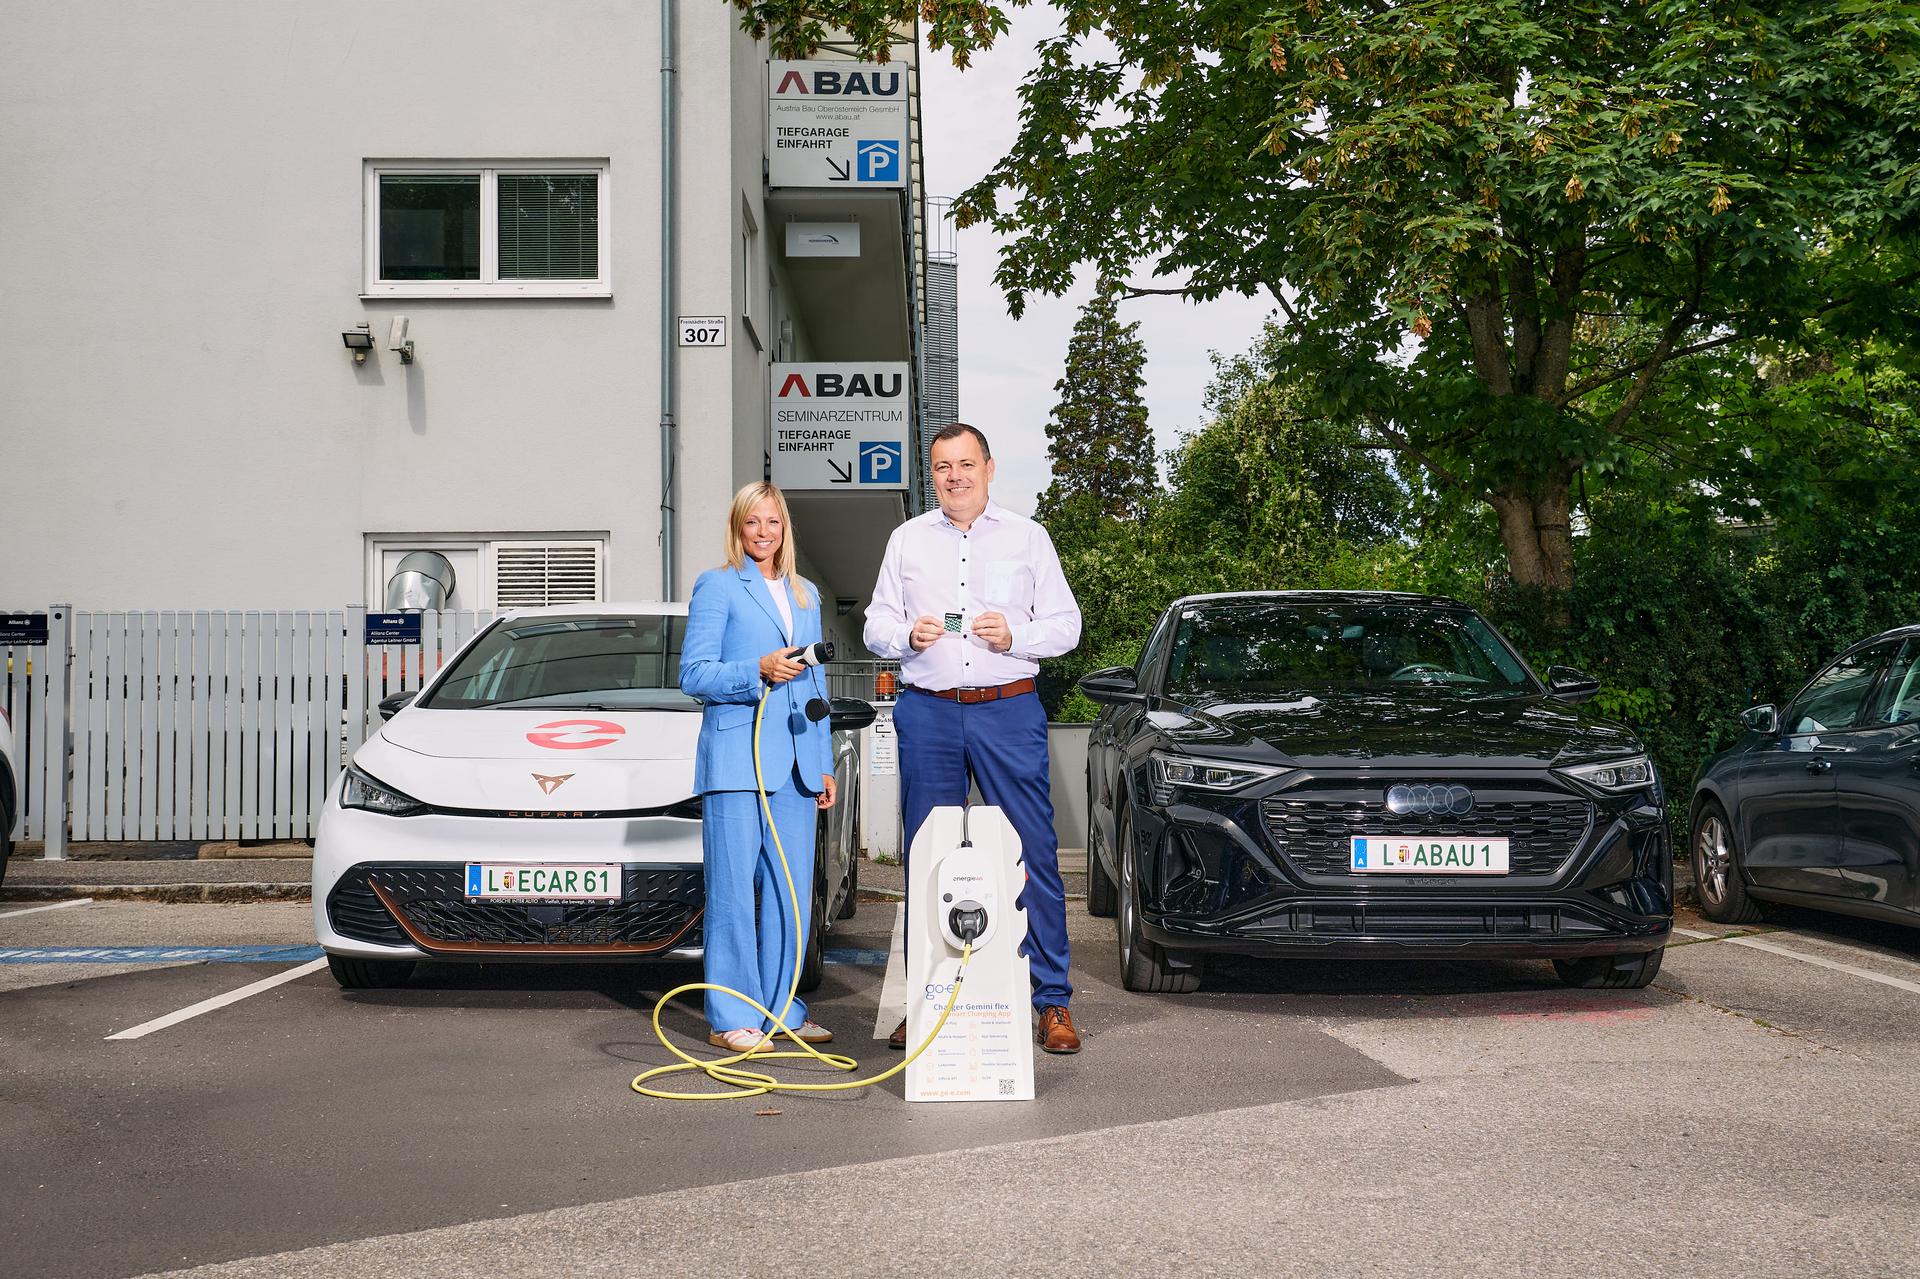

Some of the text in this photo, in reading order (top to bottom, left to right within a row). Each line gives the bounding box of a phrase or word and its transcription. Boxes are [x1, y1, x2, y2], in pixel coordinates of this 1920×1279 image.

[776, 70, 899, 95] ABAU
[776, 104, 900, 113] Austria Bau Oberösterreich GesmbH
[776, 127, 849, 137] TIEFGARAGE
[776, 139, 833, 149] EINFAHRT
[685, 328, 720, 343] 307
[778, 373, 902, 398] ABAU
[777, 410, 902, 422] SEMINARZENTRUM
[778, 430, 851, 440] TIEFGARAGE
[778, 442, 835, 452] EINFAHRT
[1383, 843, 1490, 867] L ABAU 1
[488, 869, 499, 892] L
[925, 984, 956, 1000] go-e
[994, 1002, 1009, 1010] flex
[967, 1010, 998, 1018] Charging
[998, 1010, 1011, 1018] App
